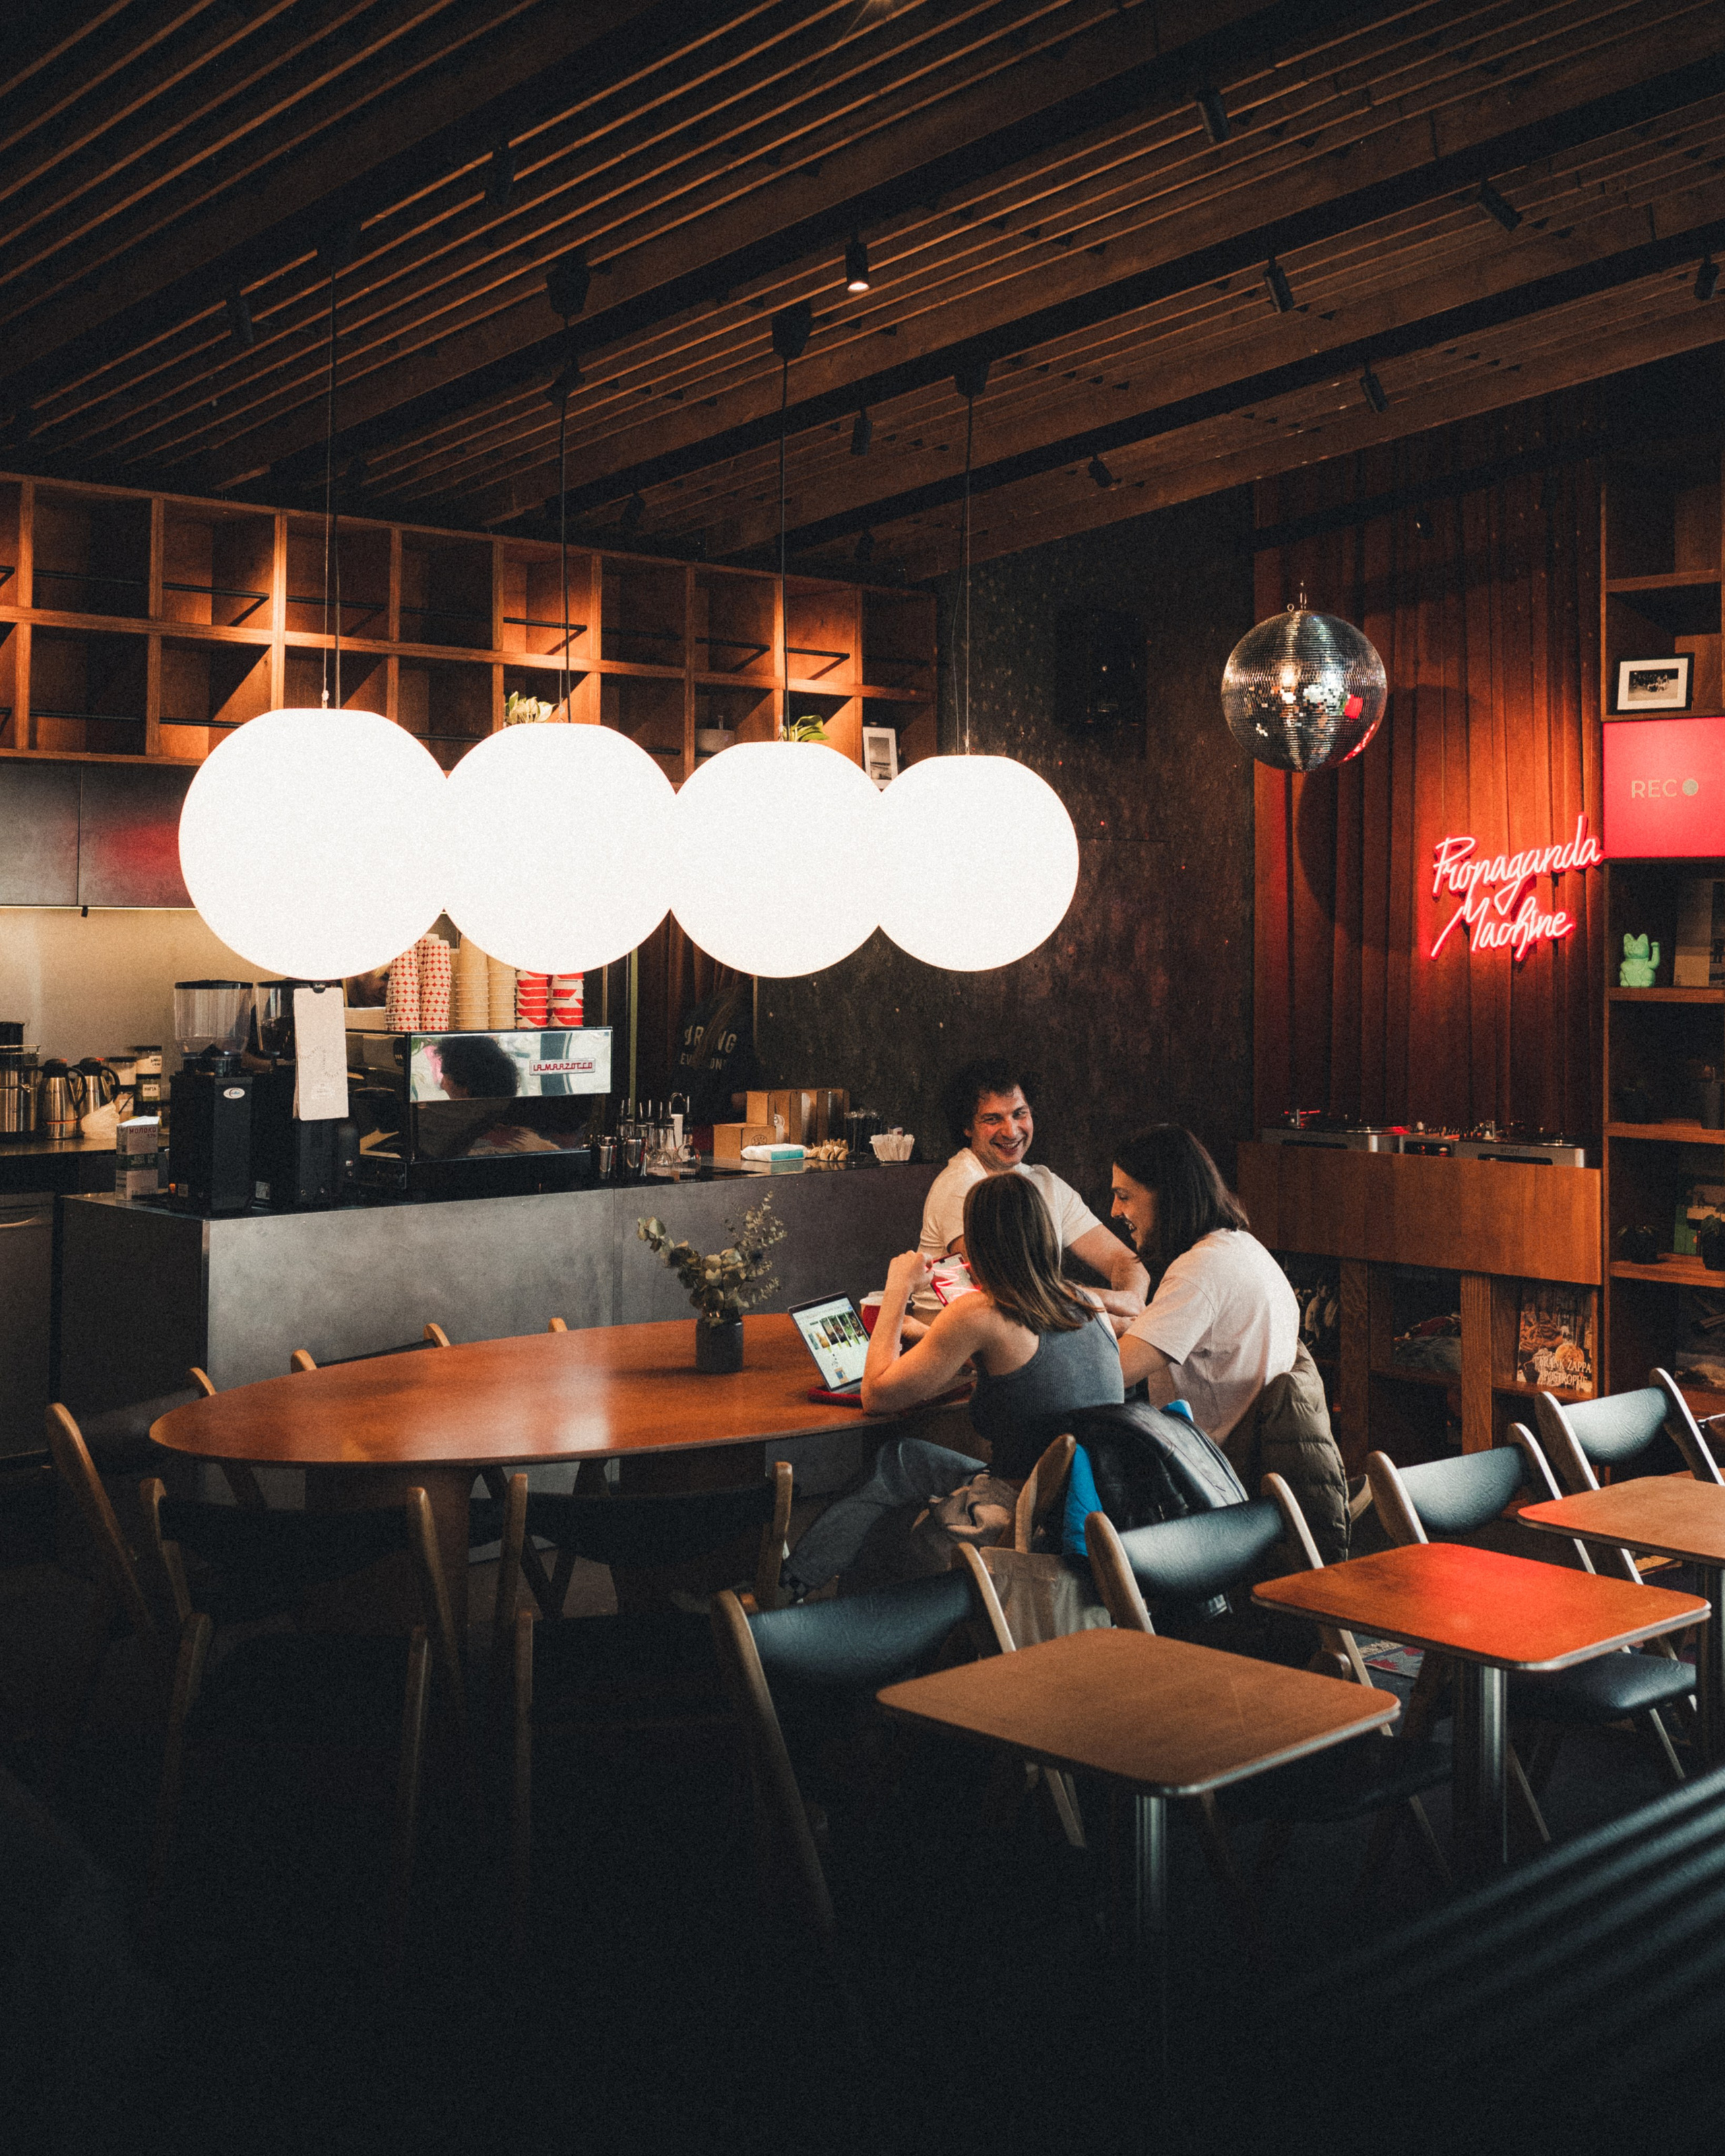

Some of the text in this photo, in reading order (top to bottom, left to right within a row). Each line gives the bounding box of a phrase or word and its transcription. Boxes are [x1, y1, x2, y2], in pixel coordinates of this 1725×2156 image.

[1631, 779, 1678, 798] REC
[1431, 813, 1603, 916] Propaganda
[1431, 896, 1575, 959] Machine
[1567, 1359, 1592, 1374] ZAPPA
